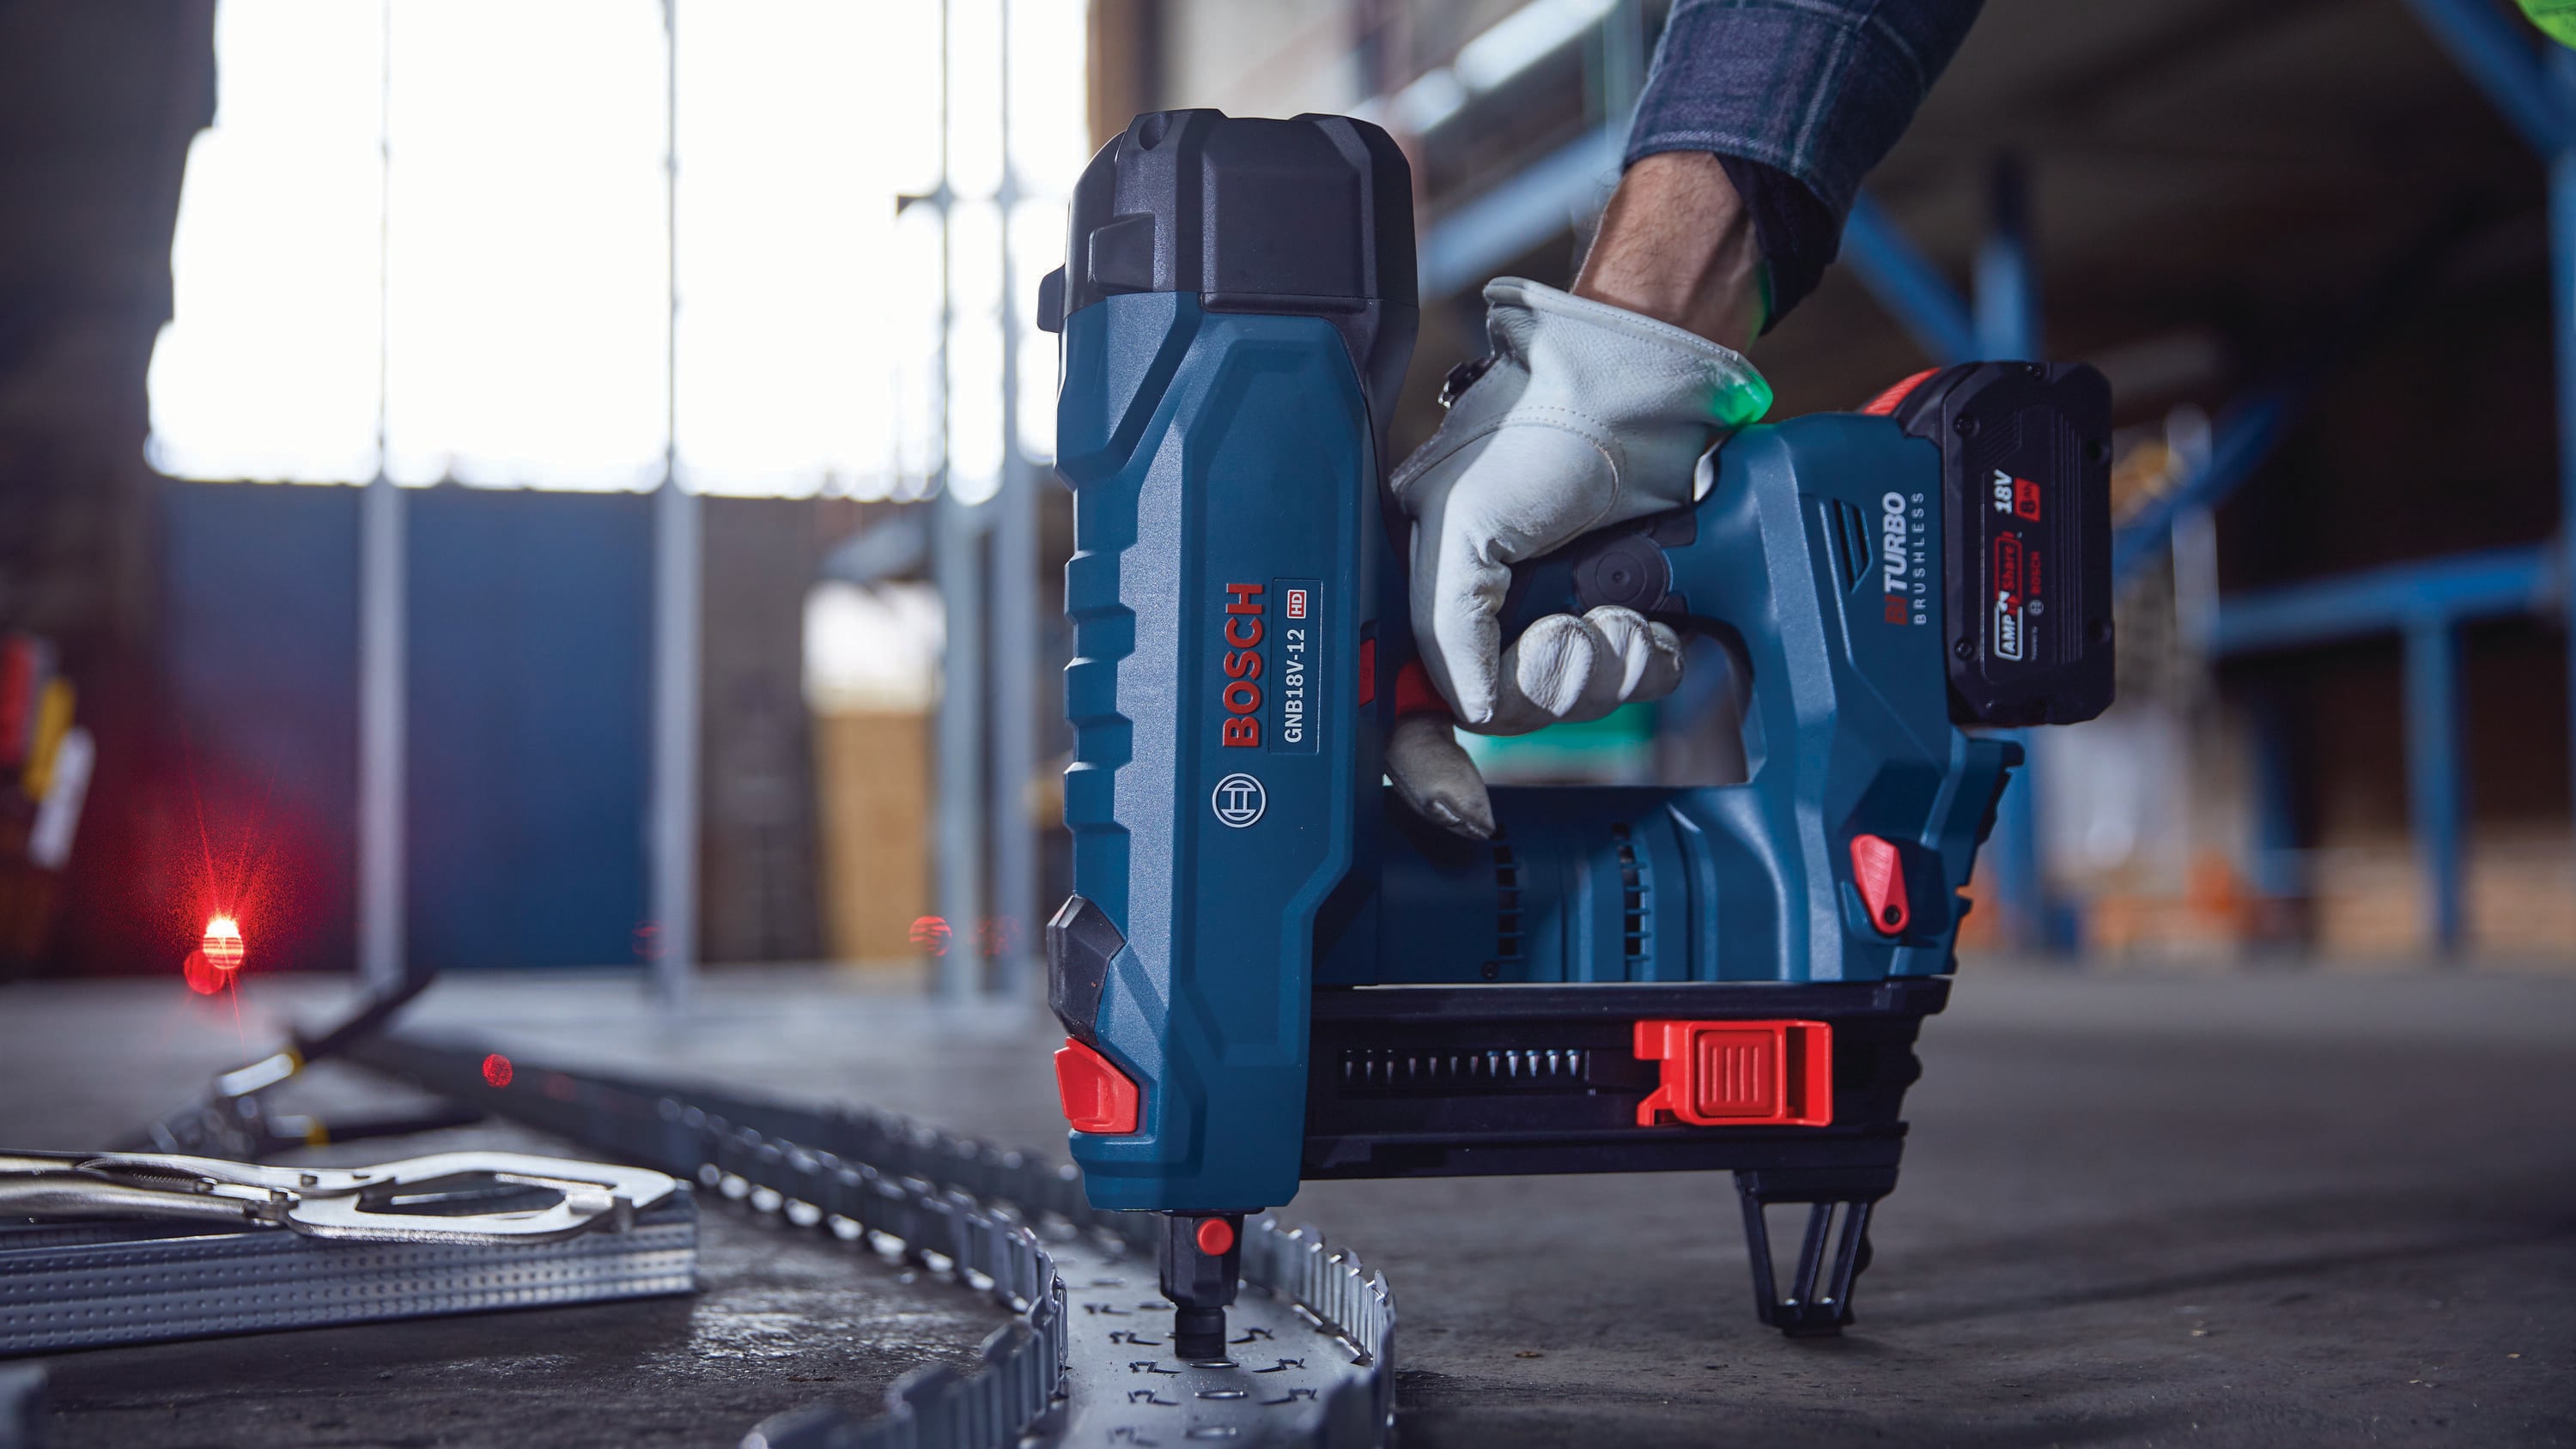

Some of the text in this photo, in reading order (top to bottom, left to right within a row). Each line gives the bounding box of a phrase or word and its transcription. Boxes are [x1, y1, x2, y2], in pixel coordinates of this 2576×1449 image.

[1994, 469, 2013, 514] 18V
[1911, 493, 1927, 625] BRUSHLESS
[2002, 545, 2016, 653] AMP Share
[2030, 551, 2042, 595] BOSCH
[1223, 584, 1263, 747] BOSCH
[1285, 593, 1304, 743] GNB18V-12 HD
